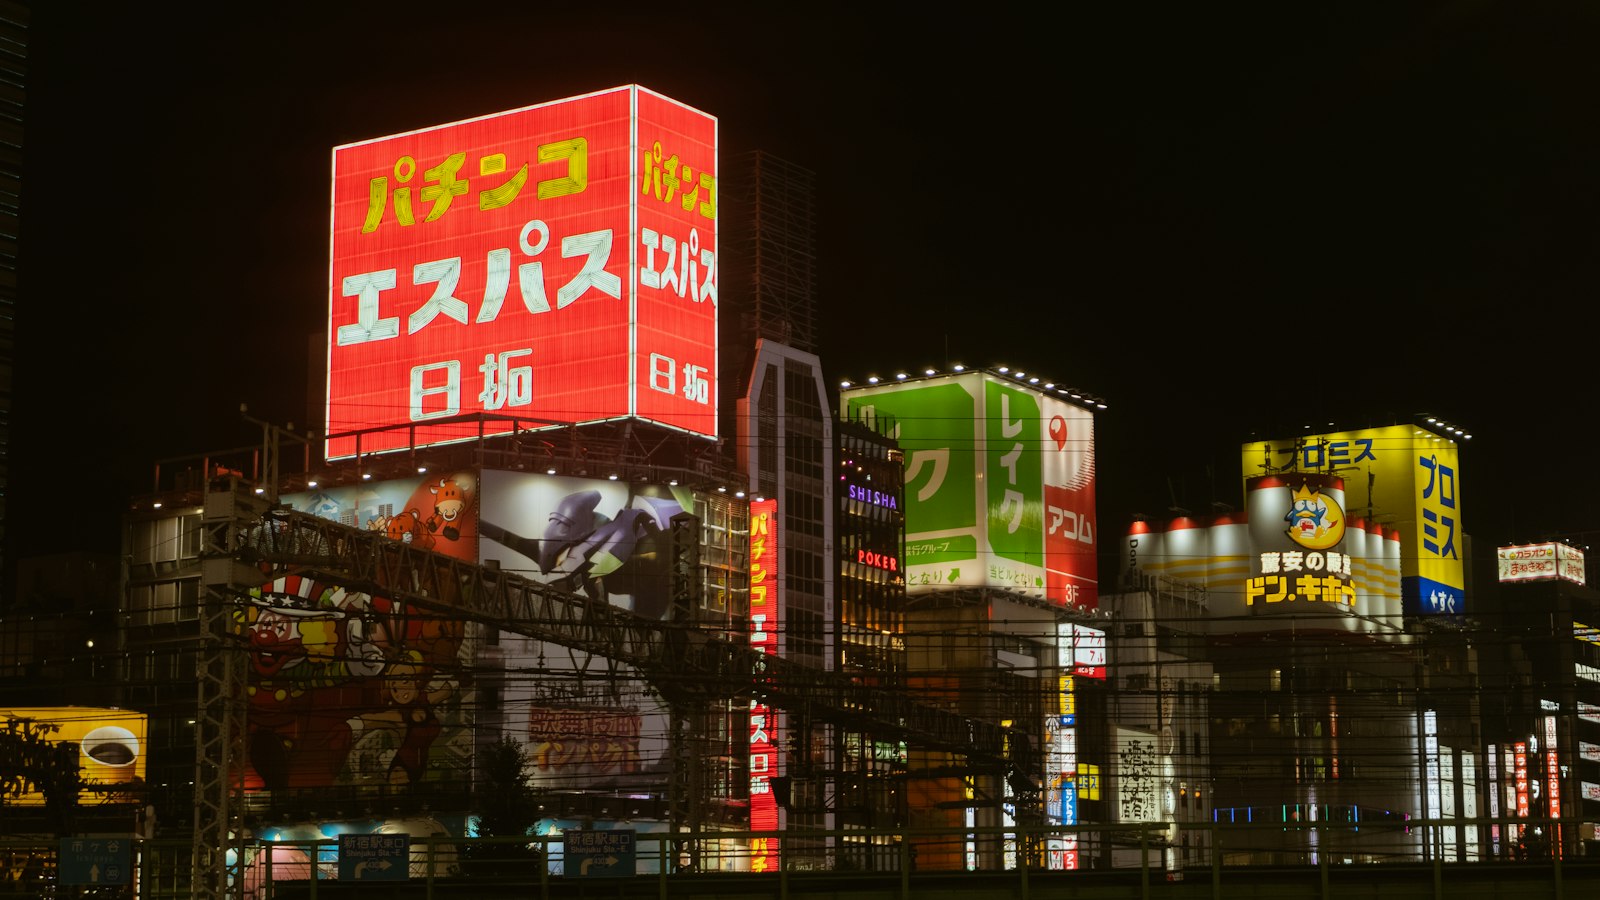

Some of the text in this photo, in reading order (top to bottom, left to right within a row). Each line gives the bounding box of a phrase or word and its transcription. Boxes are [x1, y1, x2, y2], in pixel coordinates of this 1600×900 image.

[362, 137, 589, 234] パチンコ
[641, 141, 717, 220] パチンコ
[337, 219, 622, 346] エスパス
[640, 227, 717, 307] エスパス
[410, 348, 533, 421] 日拓
[650, 353, 709, 404] 日拓
[1000, 393, 1024, 534] レイク
[850, 484, 897, 509] SHISHA
[1048, 505, 1093, 544] アコム
[751, 512, 768, 605] パチンコ
[858, 549, 897, 571] POKER
[1511, 560, 1553, 576] まねきねこ
[1516, 549, 1547, 559] カラオケ
[908, 570, 943, 586] となり
[1065, 584, 1080, 603] 3F
[343, 835, 404, 849] 新宿駅東口
[568, 832, 630, 846] 新宿駅東口
